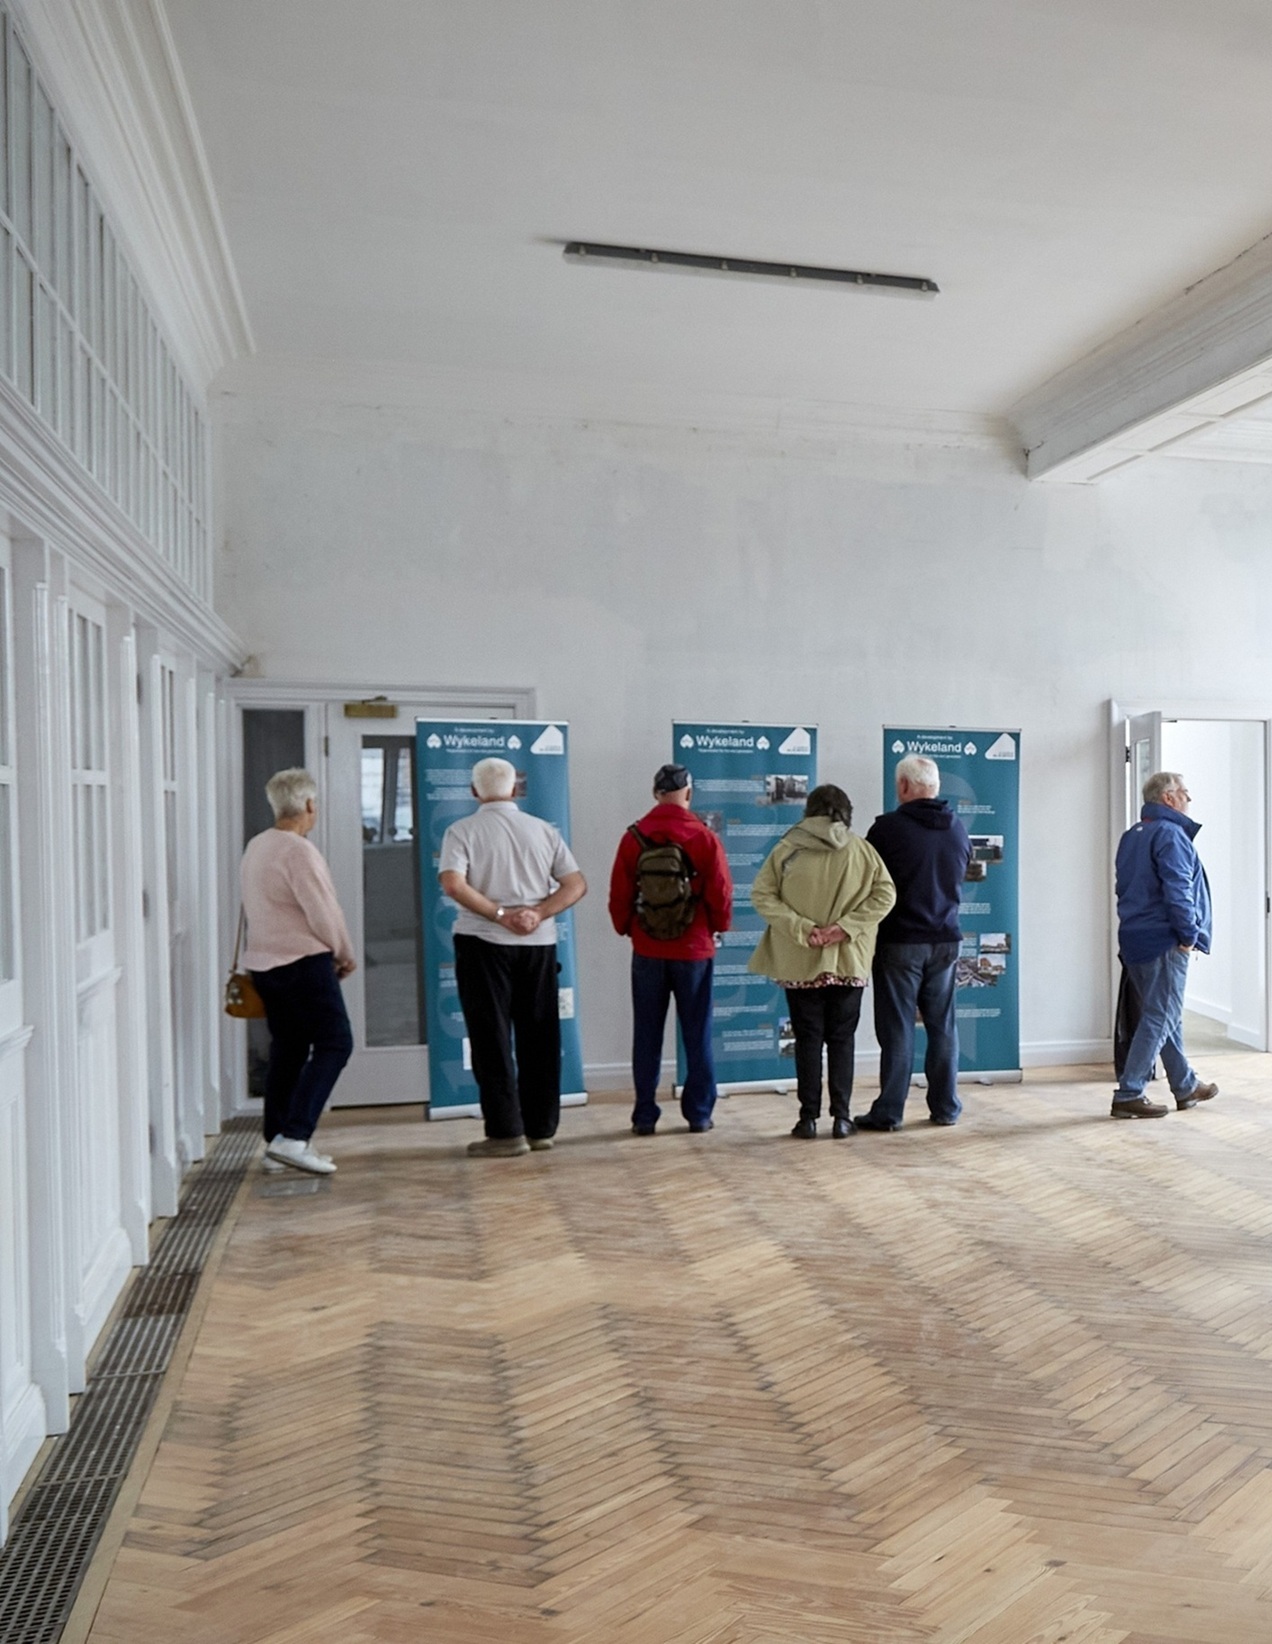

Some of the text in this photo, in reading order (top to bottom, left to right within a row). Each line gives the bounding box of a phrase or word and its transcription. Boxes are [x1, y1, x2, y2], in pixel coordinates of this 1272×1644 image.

[443, 734, 505, 748] Wykeland
[696, 735, 754, 749] Wykeland
[906, 741, 962, 754] Wykeland
